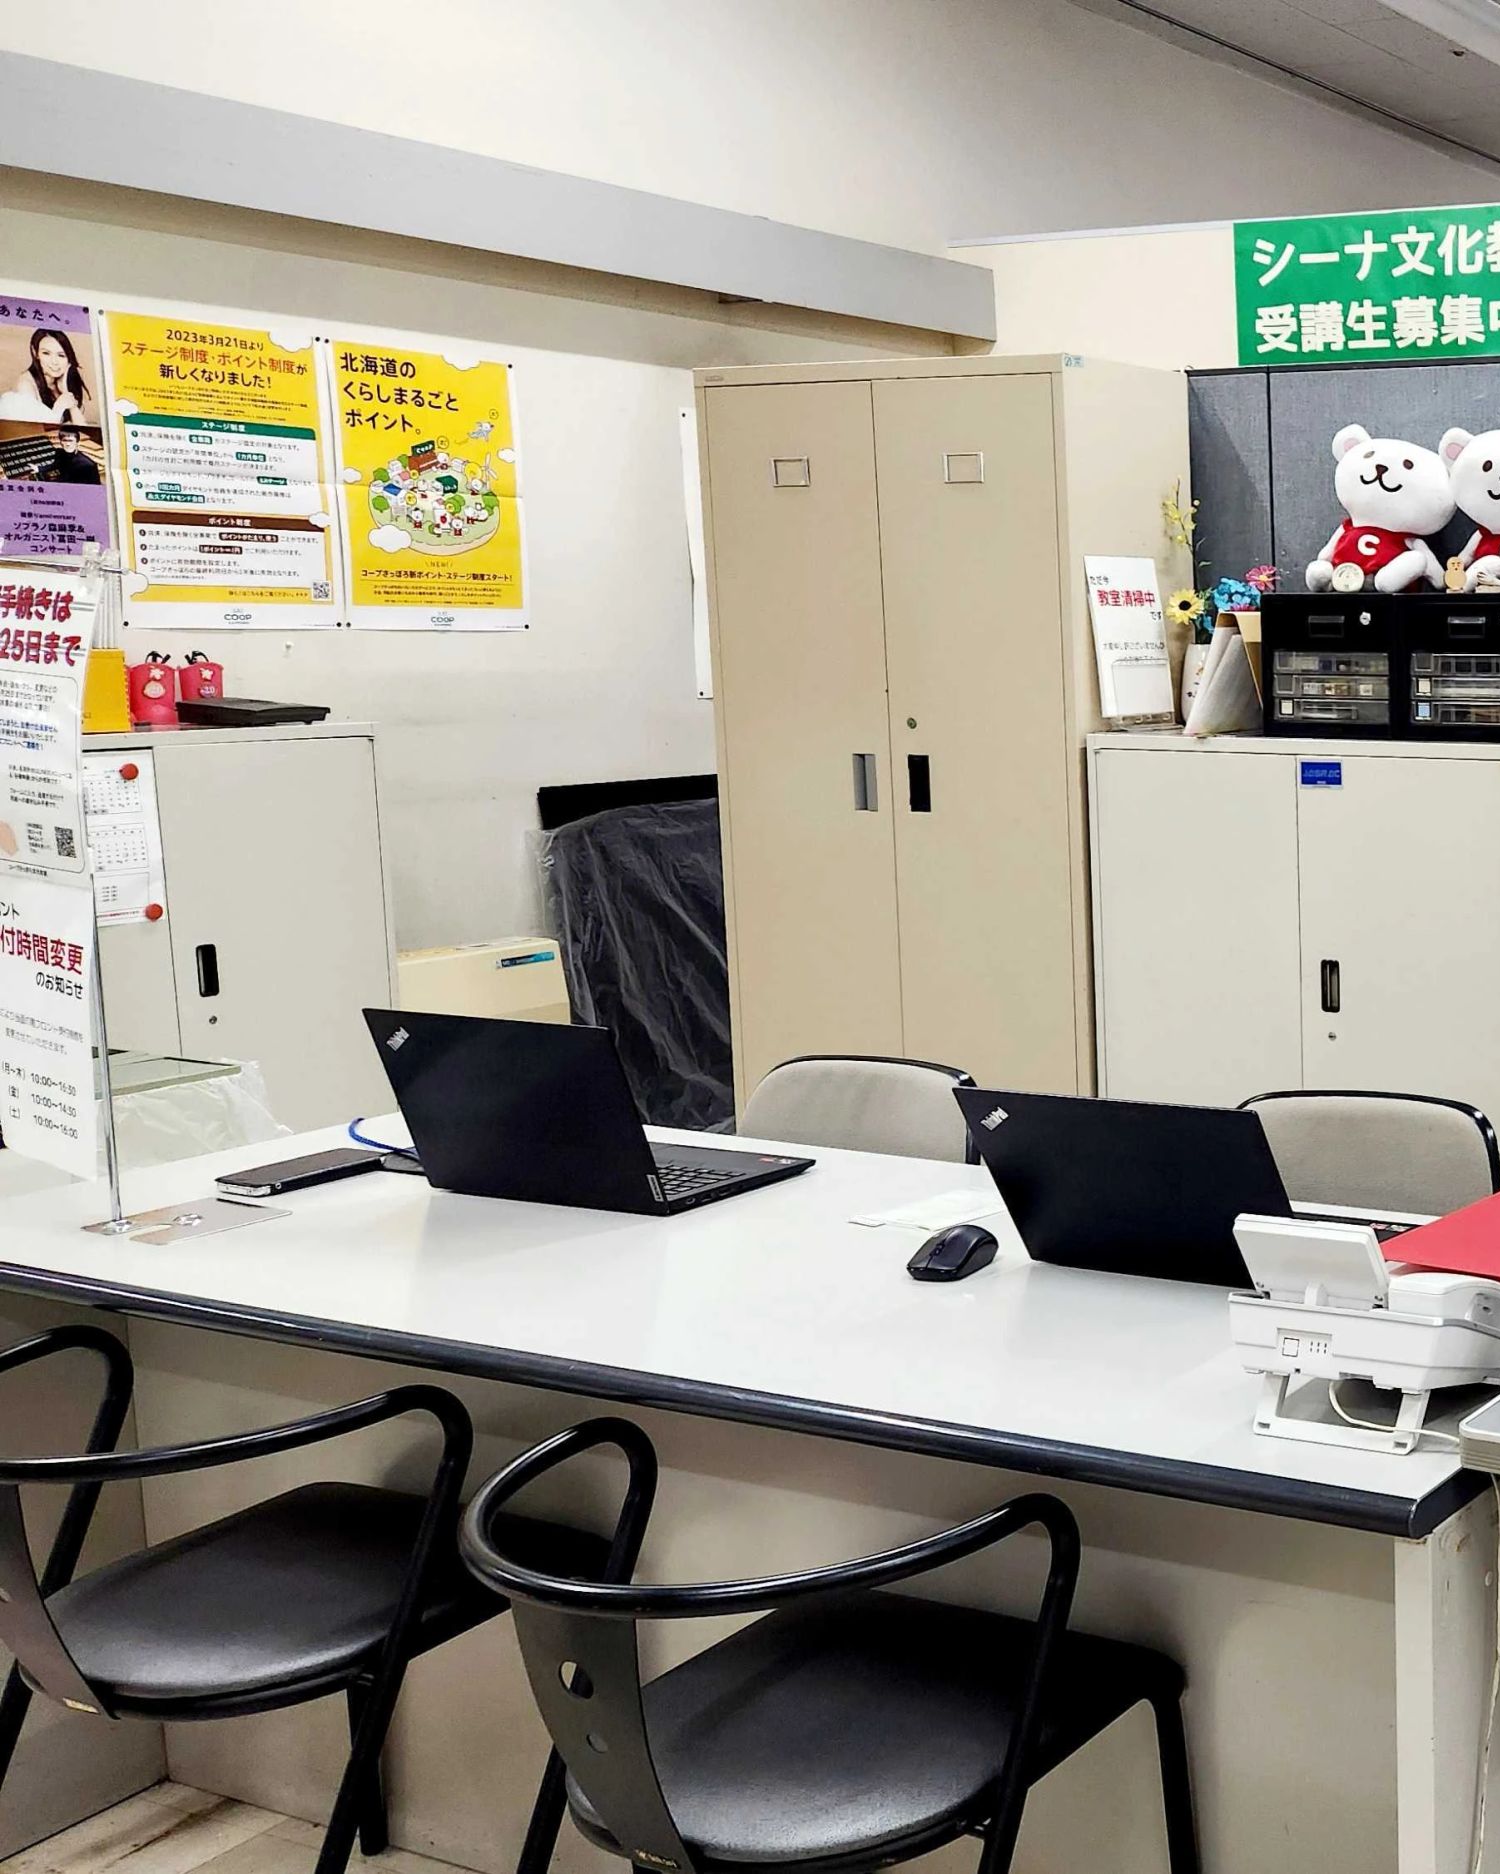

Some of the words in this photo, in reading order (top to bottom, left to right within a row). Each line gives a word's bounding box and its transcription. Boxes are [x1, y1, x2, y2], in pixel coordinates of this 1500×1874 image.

[0, 304, 70, 325] あなたへ。
[166, 329, 264, 351] 2023年3月21日より
[121, 341, 307, 376] ステージ制度・ポイント制度が
[340, 352, 416, 379] 北海道の
[159, 363, 272, 389] 新しくなりました！
[343, 381, 459, 412] くらしまるごと
[201, 421, 246, 432] ステージ制度
[345, 409, 421, 435] ポイント。
[208, 517, 251, 527] ポイント制度
[30, 545, 72, 554] コンサート
[1358, 534, 1380, 556] C
[0, 585, 74, 622] 手続きは
[1097, 589, 1156, 607] 教室清掃中
[1150, 611, 1162, 620] です
[0, 627, 81, 667] 25日まで
[0, 901, 20, 921] ント
[0, 924, 84, 975] 付時間変更
[36, 971, 84, 1000] のお知らせ
